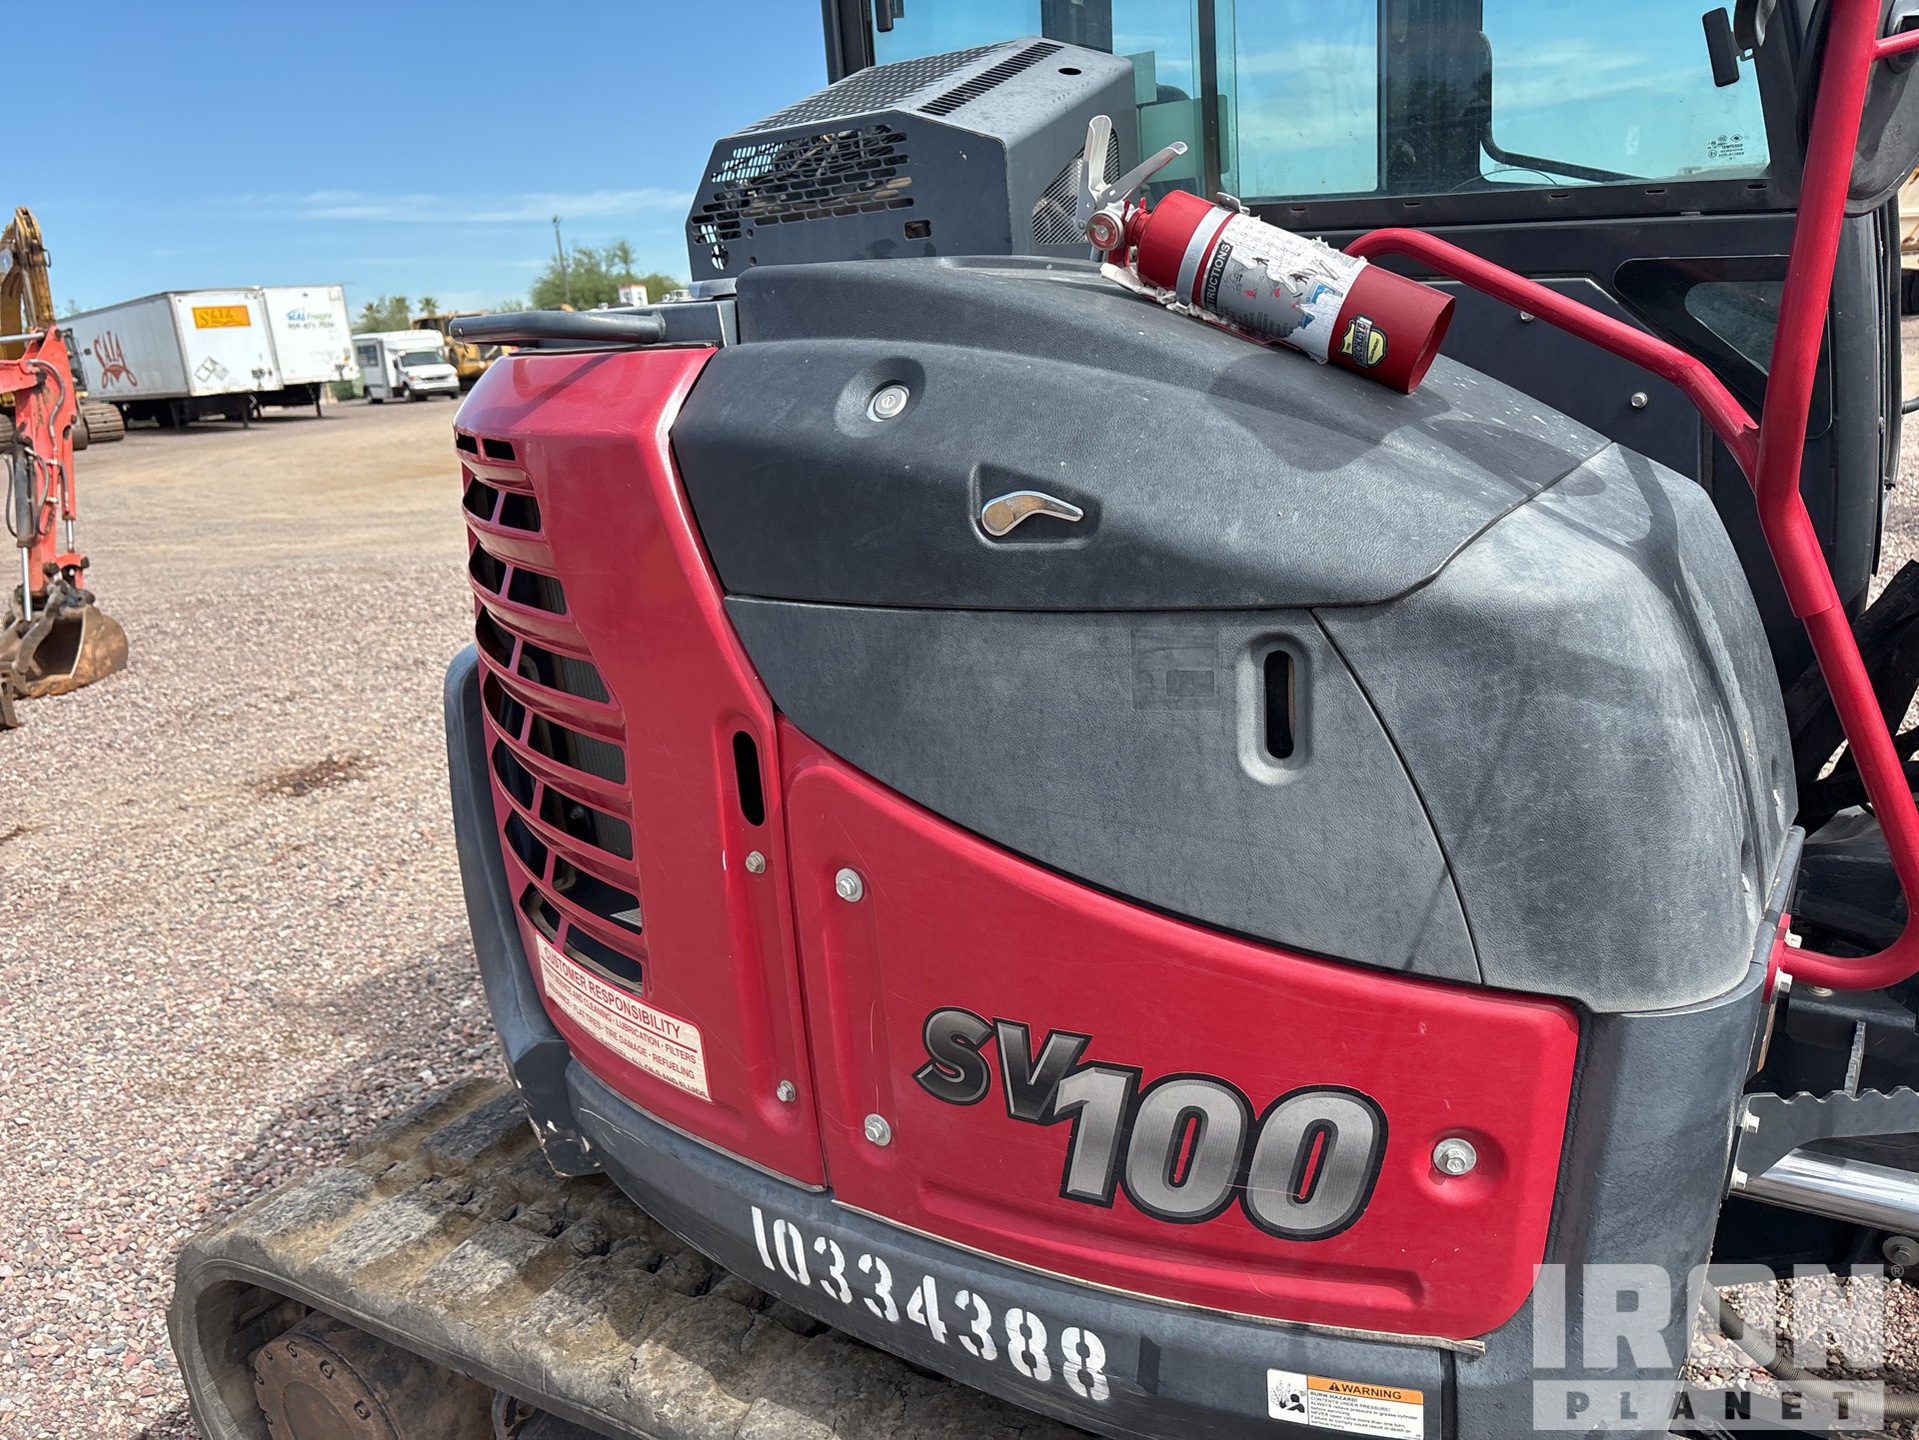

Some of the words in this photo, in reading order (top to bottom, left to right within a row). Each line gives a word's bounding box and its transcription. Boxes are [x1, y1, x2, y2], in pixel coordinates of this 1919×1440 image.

[1206, 243, 1231, 311] STRUCTIONS
[1353, 322, 1366, 363] BUCKEYE
[544, 946, 588, 991] CUSTOMER
[588, 980, 680, 1039] RESPONSIBILITY
[583, 997, 612, 1022] CLEANING
[615, 1018, 660, 1048] LUBRICATION
[665, 1043, 697, 1064] FILTERS
[604, 1025, 618, 1041] TIRE
[619, 1035, 648, 1057] DAMAGE
[652, 1052, 695, 1080] REFUELING
[911, 1006, 1389, 1241] SV100
[751, 1206, 1110, 1401] 10334388
[1341, 1383, 1402, 1400] WARNING
